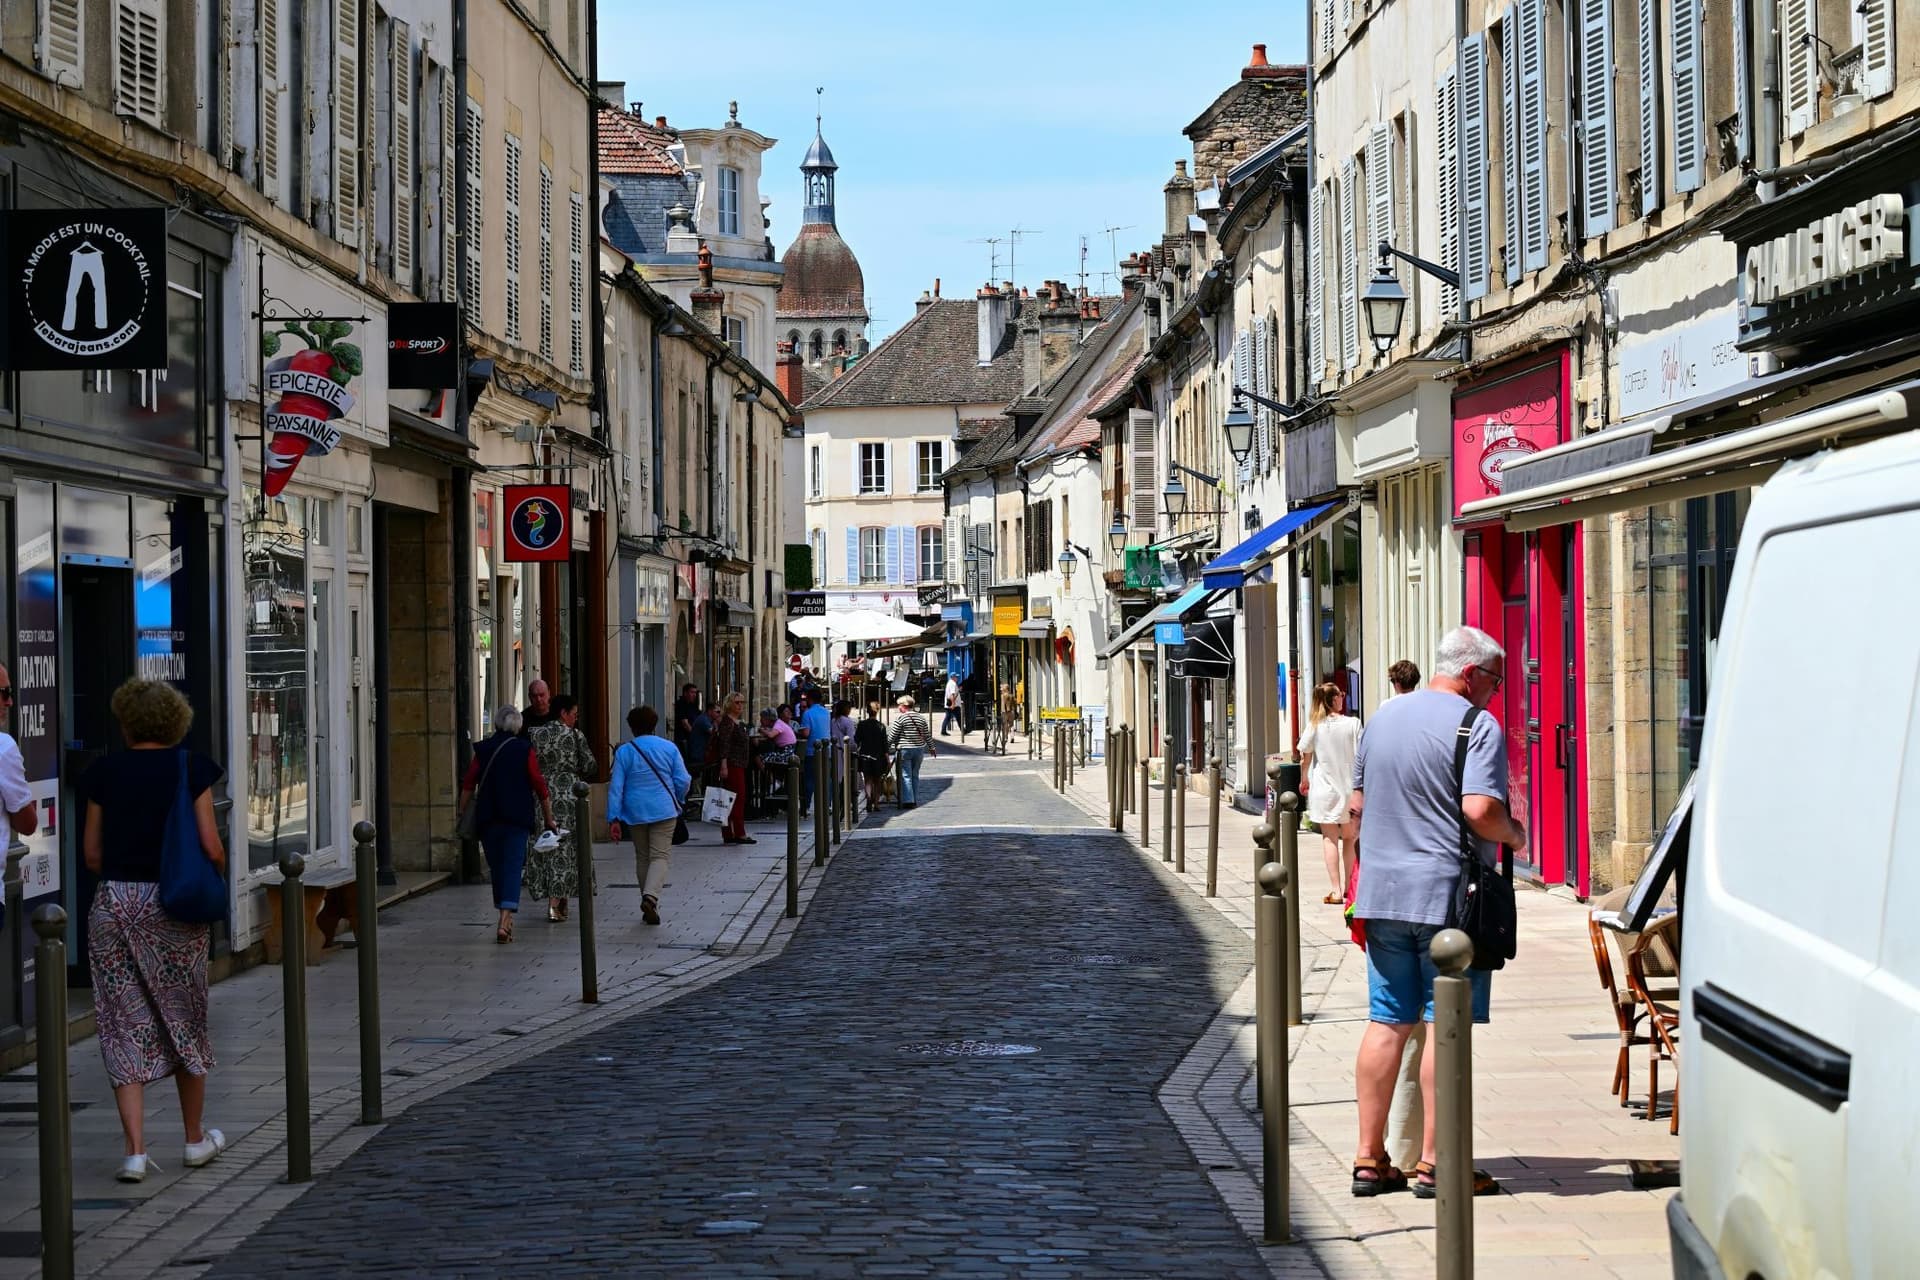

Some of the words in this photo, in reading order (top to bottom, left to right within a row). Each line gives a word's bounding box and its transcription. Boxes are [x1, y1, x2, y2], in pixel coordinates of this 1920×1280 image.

[58, 223, 82, 239] EST
[84, 222, 104, 234] UN
[27, 232, 60, 267] MODE
[105, 227, 152, 281] COCKTAIL
[1744, 193, 1904, 307] CHALLENGER
[22, 267, 35, 283] LA
[38, 323, 137, 354] lebarajeans.com
[269, 373, 347, 406] EPICERIE
[266, 414, 340, 450] PAYSANNE
[791, 606, 825, 614] AFFLELOU
[802, 597, 824, 605] ALAIN
[142, 652, 185, 681] LIQUIDATION
